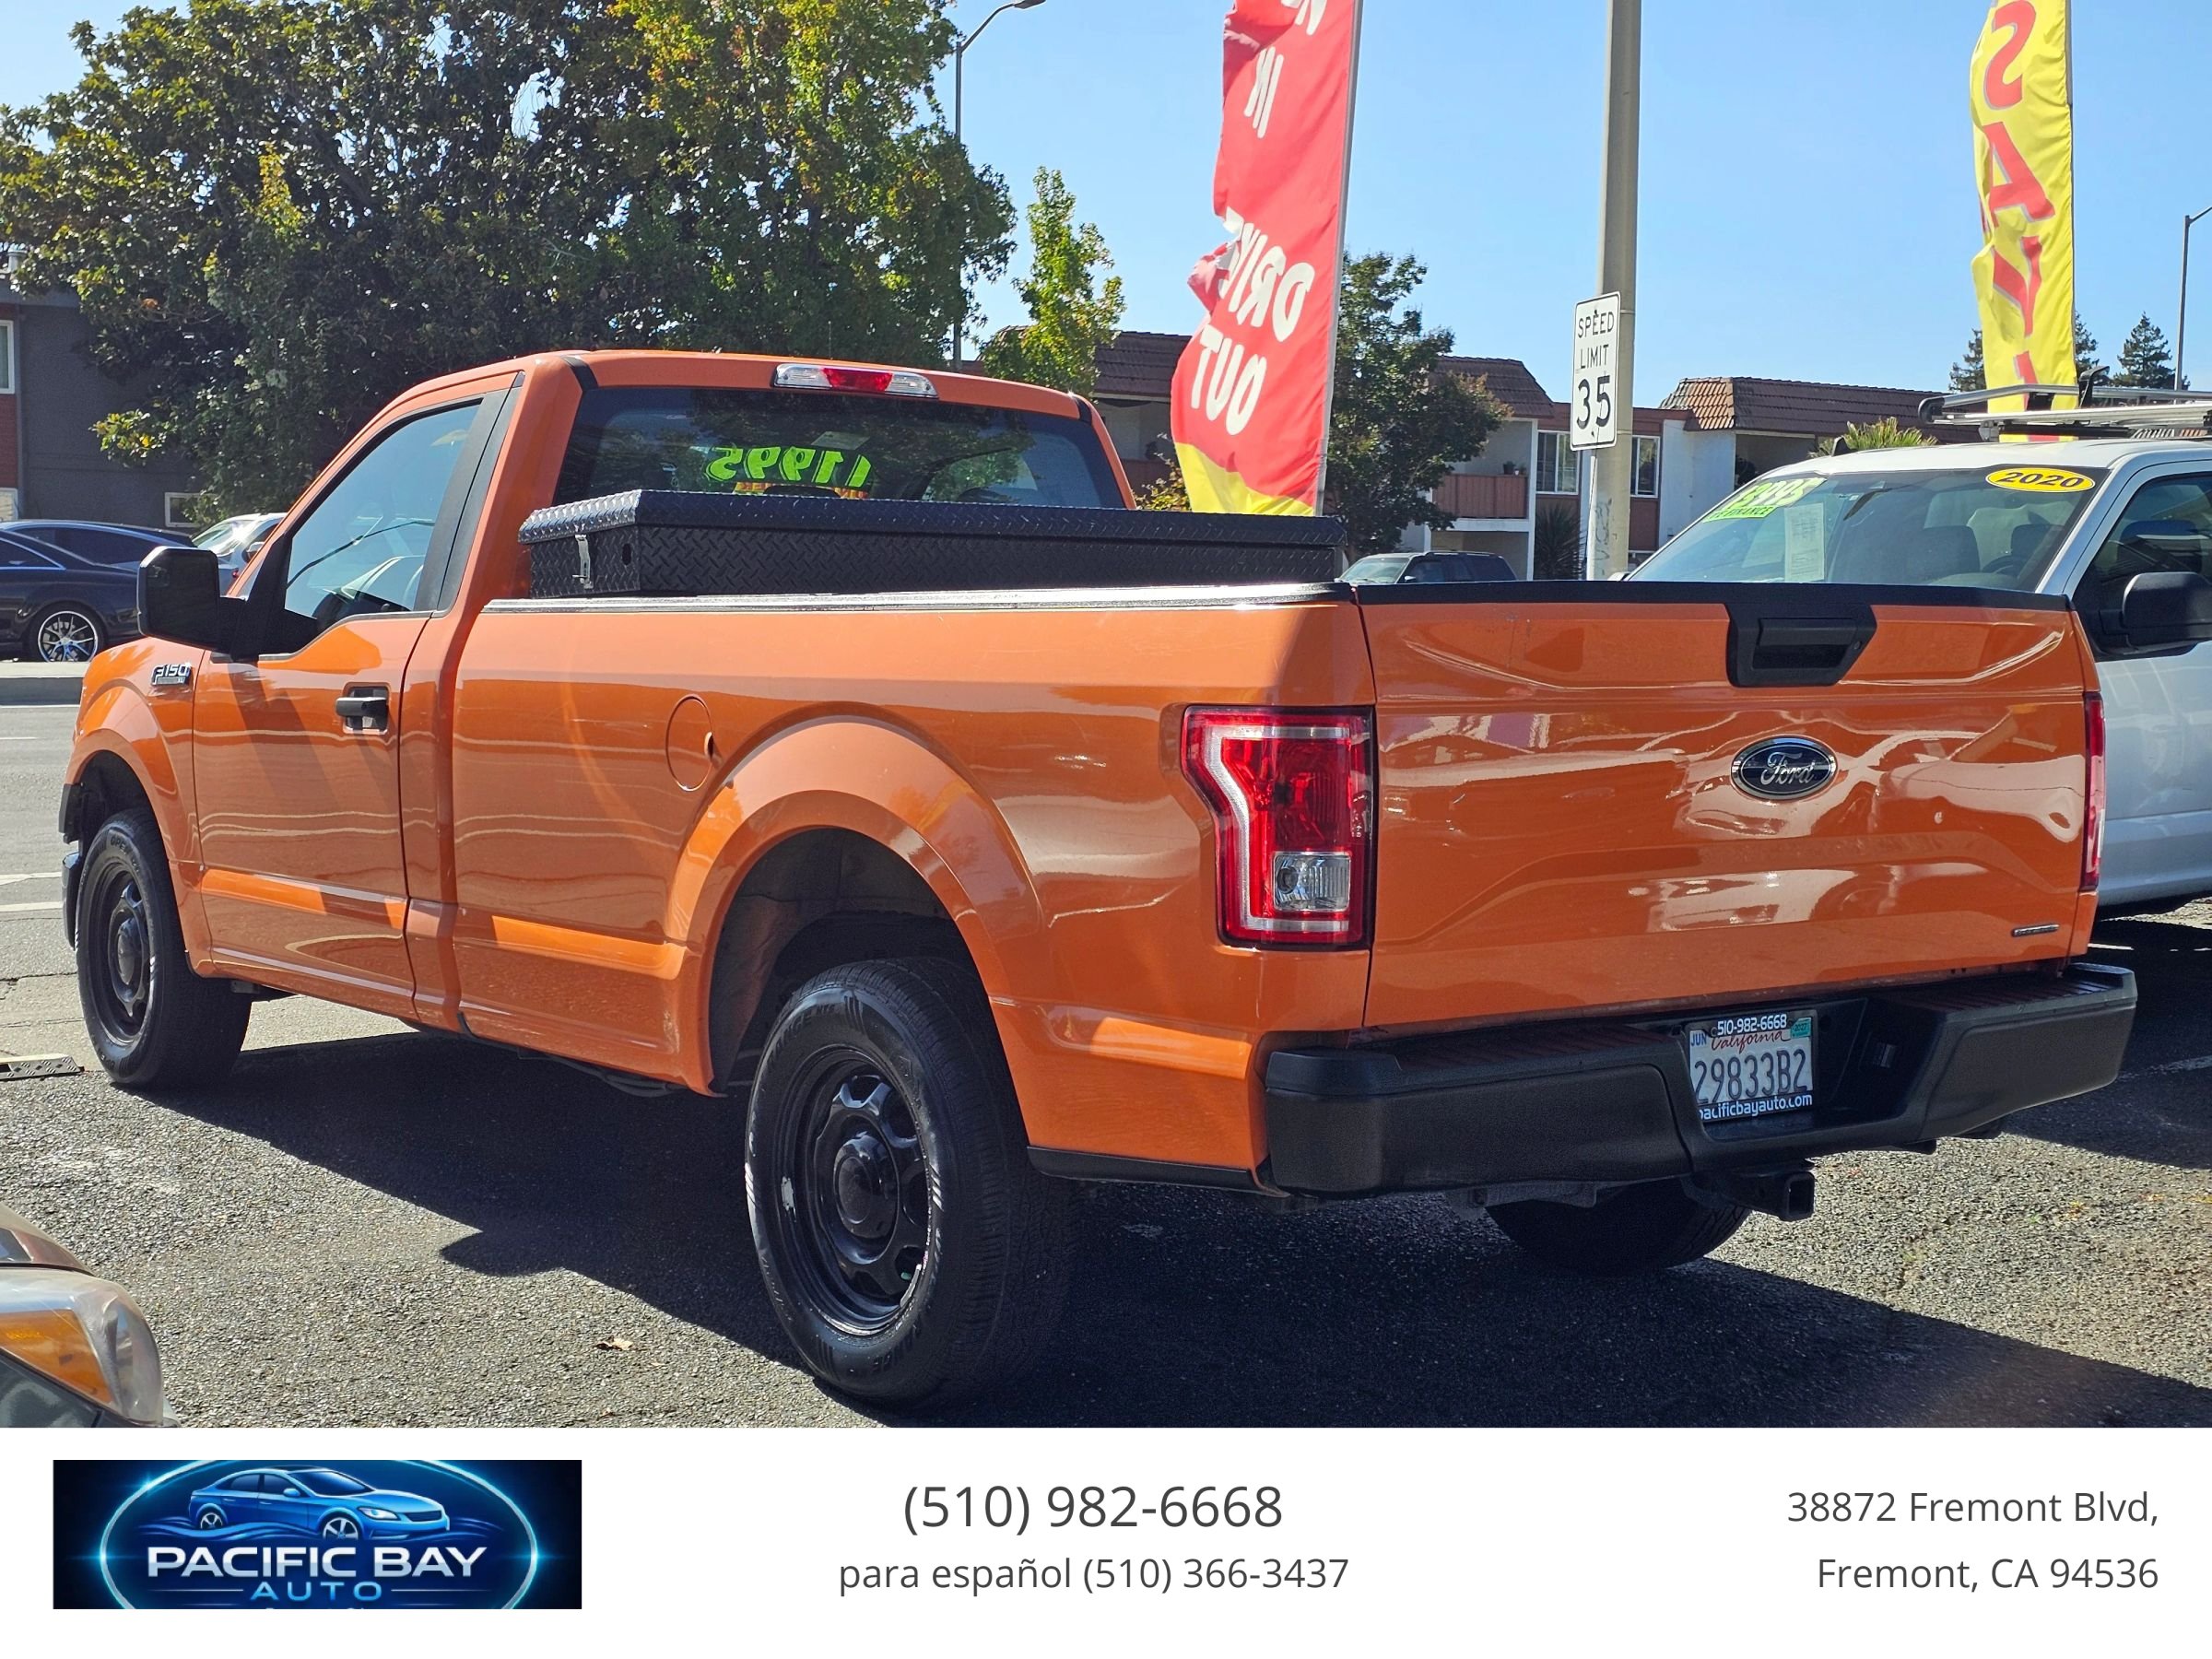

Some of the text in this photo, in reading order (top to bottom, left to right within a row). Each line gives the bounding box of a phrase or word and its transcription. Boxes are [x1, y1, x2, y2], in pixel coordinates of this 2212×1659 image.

[1577, 311, 1615, 338] SPEED
[1580, 344, 1609, 369] LIMIT
[1576, 375, 1611, 429] 35
[1996, 472, 2085, 488] 2020
[1760, 751, 1816, 785] Ford
[1717, 1014, 1787, 1036] 510-982-6668
[1694, 1048, 1808, 1105] 29833B2
